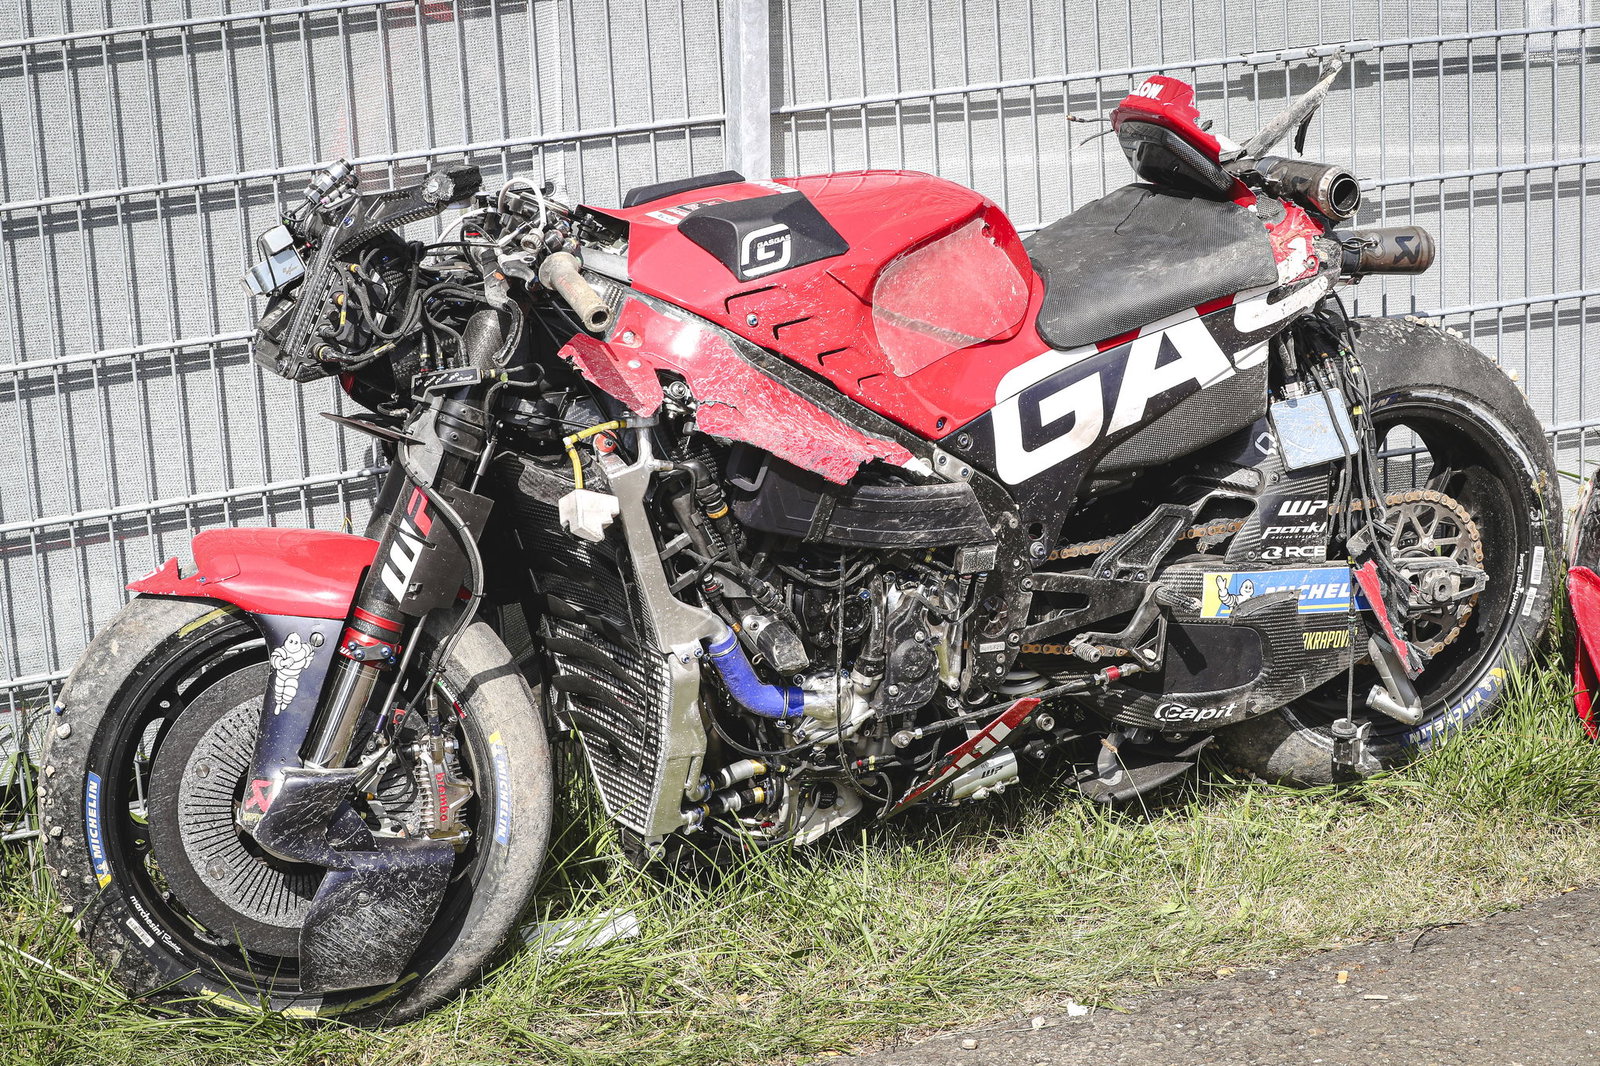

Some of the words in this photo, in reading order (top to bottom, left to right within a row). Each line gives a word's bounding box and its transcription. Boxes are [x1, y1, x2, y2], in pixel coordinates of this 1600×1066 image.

[1278, 500, 1328, 516] WP
[1154, 702, 1238, 722] Capit
[88, 780, 102, 859] MICHELIN
[436, 772, 450, 822] brembo
[497, 760, 509, 838] MICHELIN
[130, 896, 164, 936] marchesini
